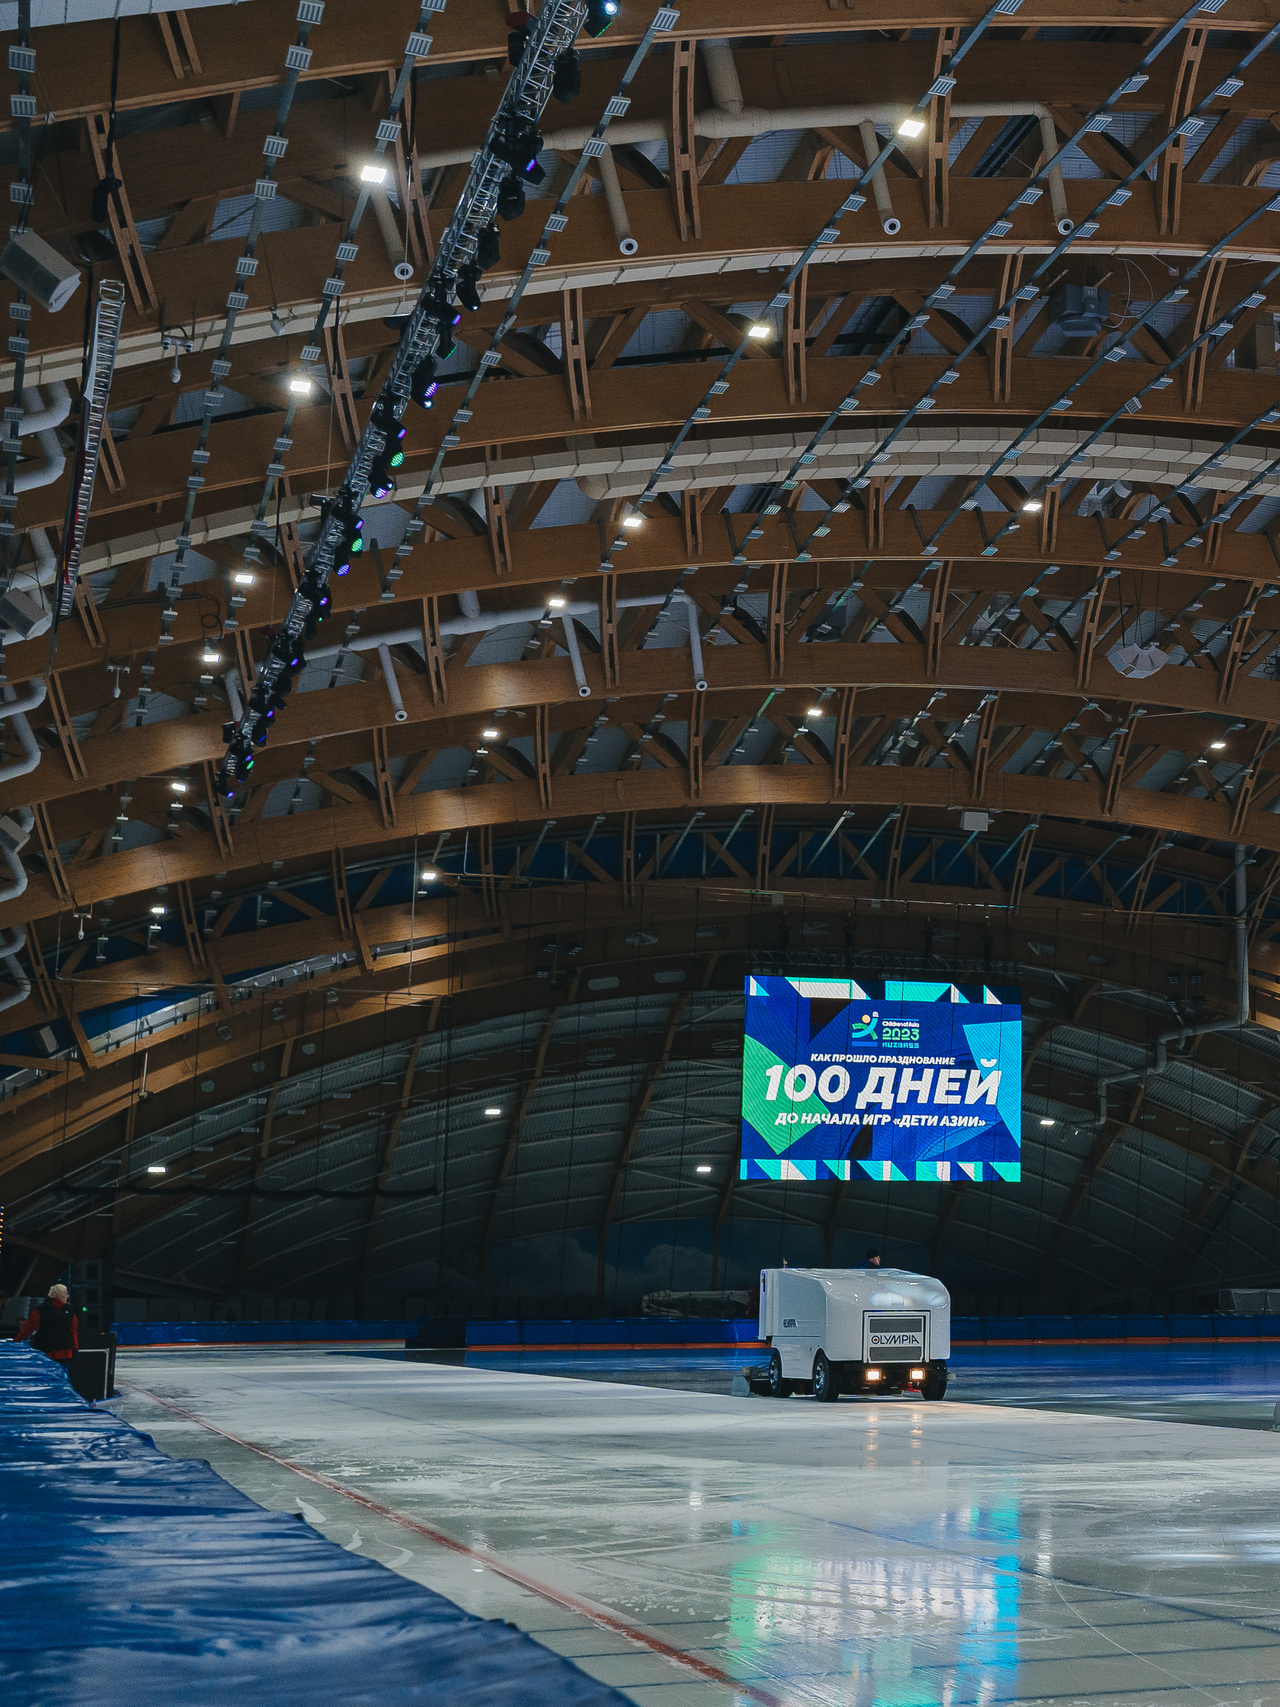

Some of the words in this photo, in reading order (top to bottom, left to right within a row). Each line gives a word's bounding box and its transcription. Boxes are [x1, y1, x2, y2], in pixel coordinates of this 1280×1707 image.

[882, 1028, 920, 1041] 2023
[811, 1053, 831, 1062] КАК
[832, 1054, 877, 1063] ПРОШЛО
[878, 1055, 956, 1065] ПРАЗДНОВАНИЕ
[765, 1064, 850, 1103] 100
[855, 1058, 1002, 1110] ДНЕЙ
[775, 1112, 799, 1126] ДО
[800, 1113, 860, 1125] НАЧАЛА
[862, 1114, 891, 1125] ИГР
[893, 1114, 939, 1128] «ДЕТИ
[939, 1115, 986, 1127] АЗИИ»
[871, 1334, 920, 1345] OLYMPIA
